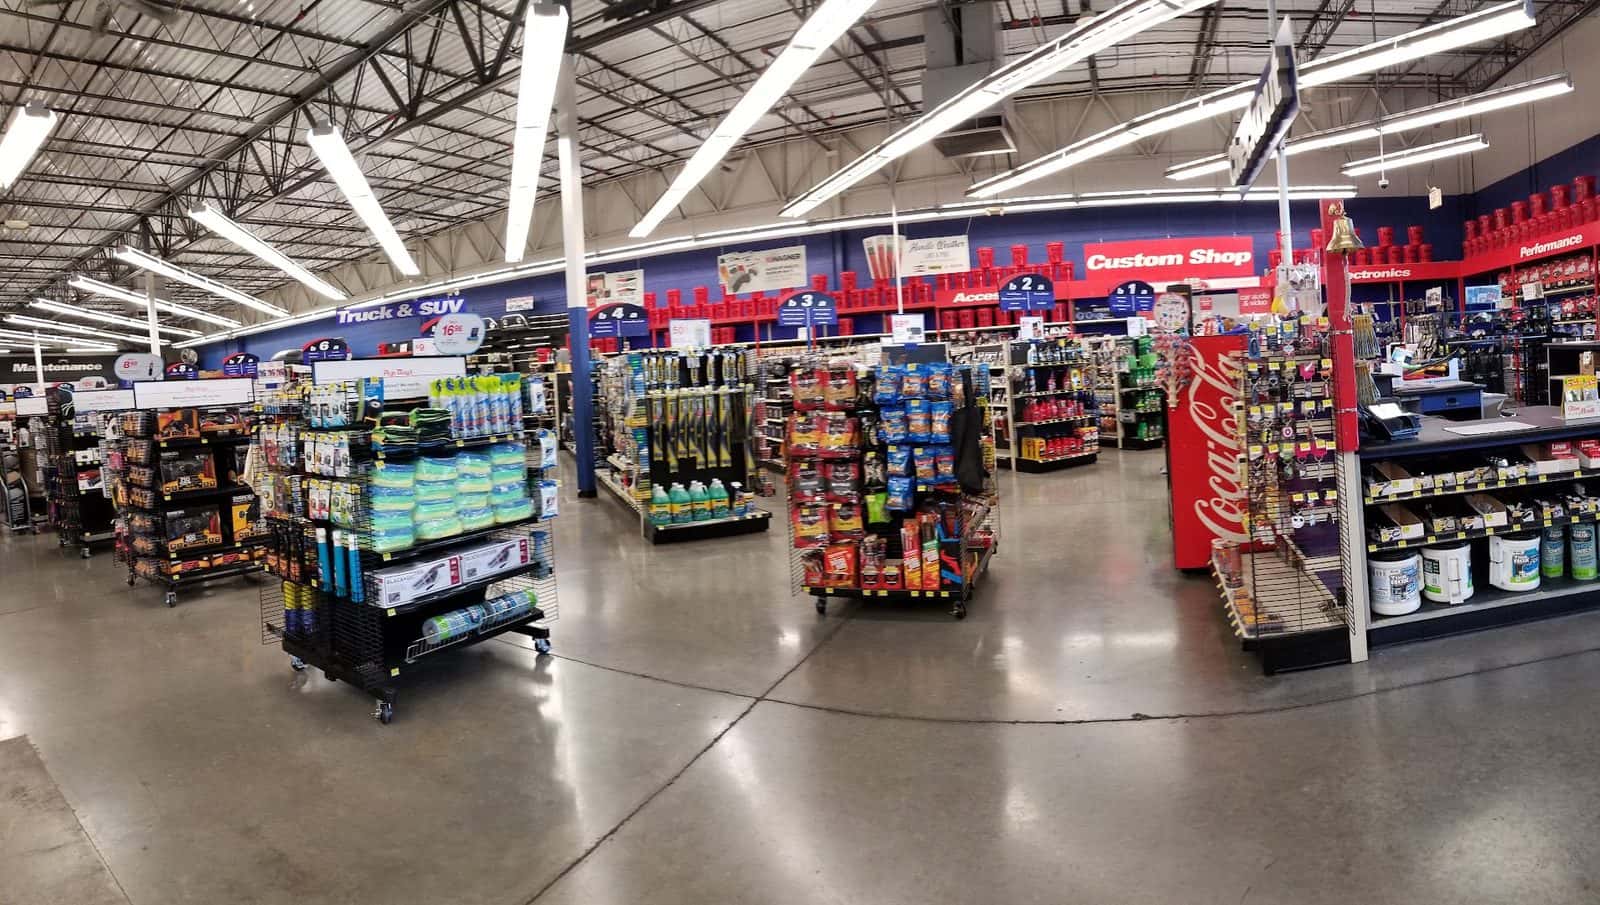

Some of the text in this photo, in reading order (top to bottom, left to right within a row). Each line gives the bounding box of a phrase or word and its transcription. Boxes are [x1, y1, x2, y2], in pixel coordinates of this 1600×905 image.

[1520, 234, 1583, 258] Performance
[1087, 249, 1252, 270] Custom Shop
[1021, 277, 1033, 290] 2
[1127, 283, 1137, 295] 1
[800, 294, 814, 307] 3
[337, 299, 464, 324] Truck & SUV
[611, 307, 625, 319] 4
[319, 341, 330, 351] 6
[12, 363, 103, 372] Mantenance
[1187, 342, 1250, 543] Coca-Cola
